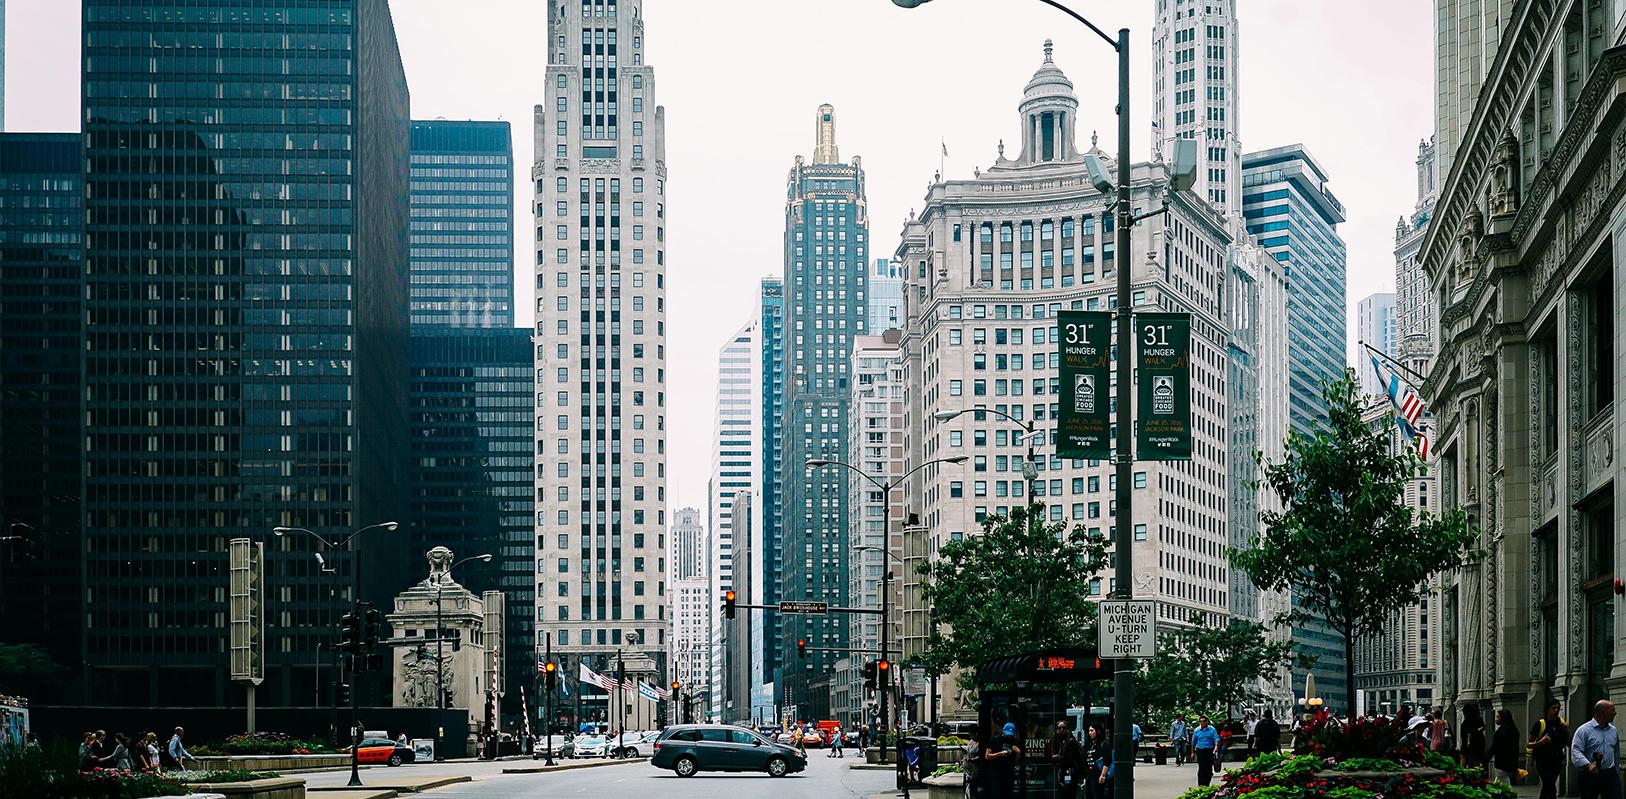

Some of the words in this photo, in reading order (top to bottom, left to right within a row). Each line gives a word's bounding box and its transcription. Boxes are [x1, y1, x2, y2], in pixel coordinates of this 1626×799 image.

[1065, 346, 1097, 355] HUNGER
[1143, 348, 1175, 356] HUNGER
[1066, 355, 1088, 363] WALK
[1103, 604, 1151, 614] MICHIGAN
[1108, 614, 1147, 624] AVENUE
[1108, 624, 1148, 634] U-TURN
[1115, 634, 1140, 644] KEEP
[1113, 644, 1142, 653] RIGHT
